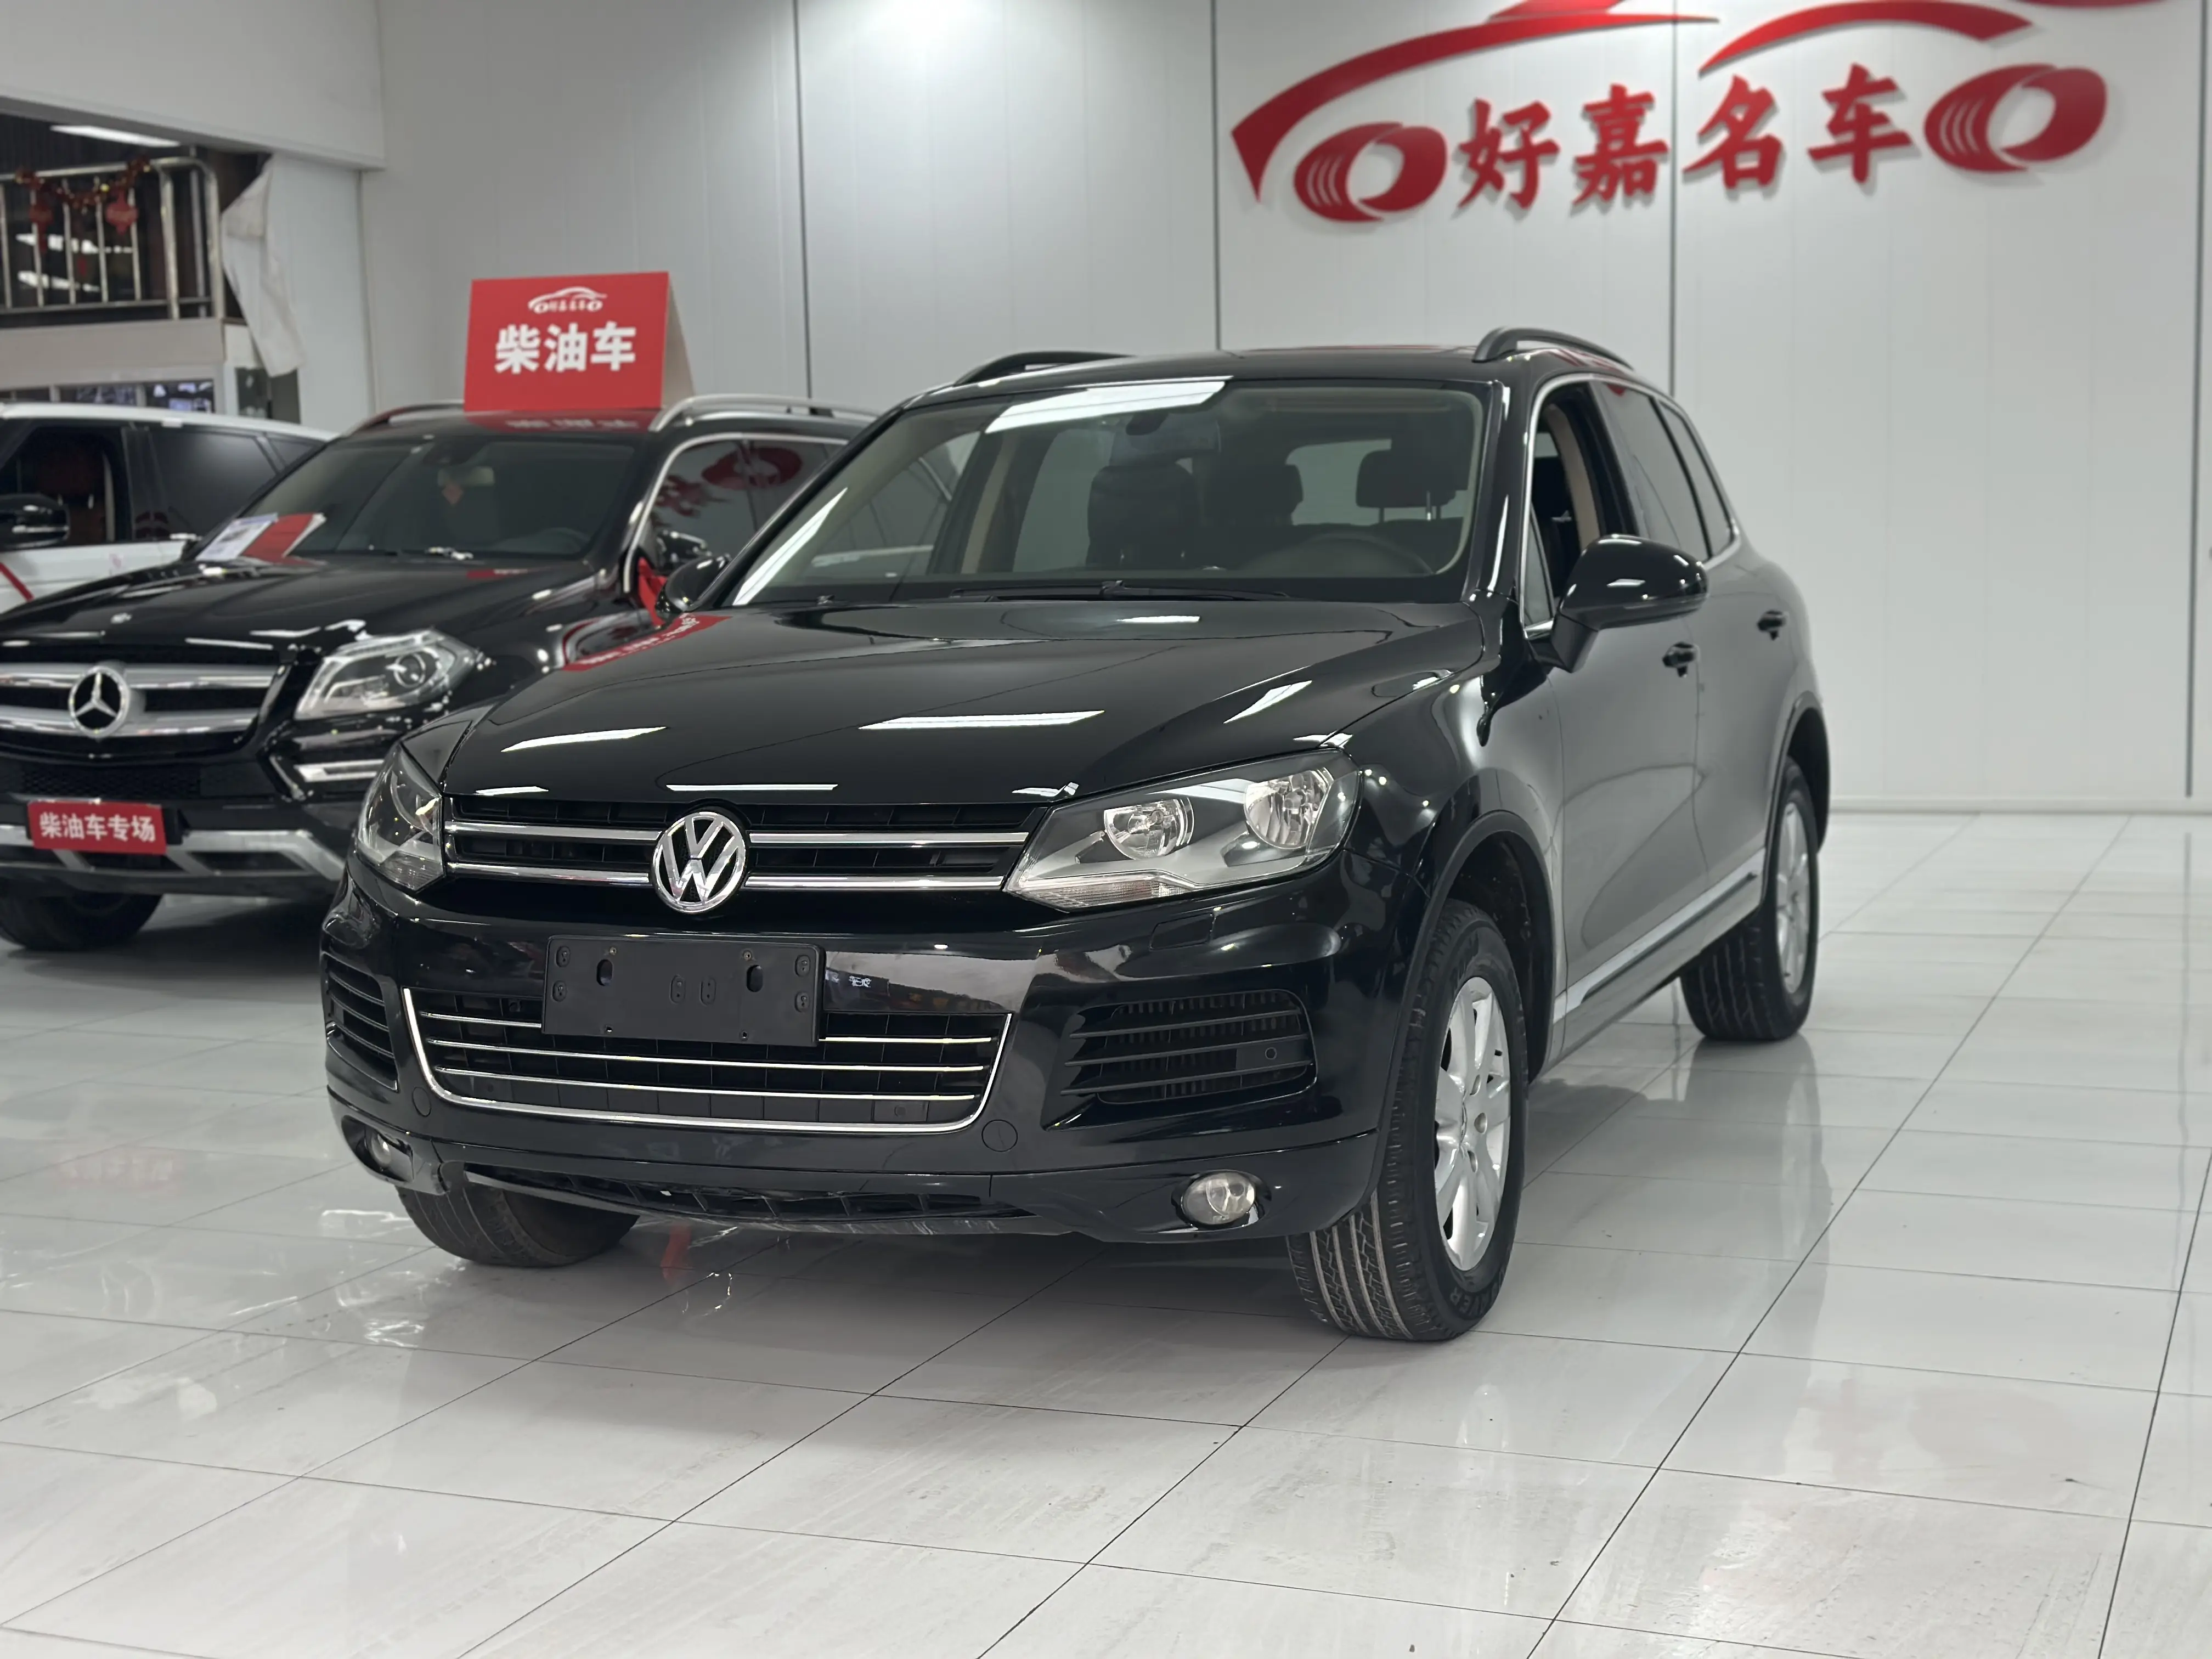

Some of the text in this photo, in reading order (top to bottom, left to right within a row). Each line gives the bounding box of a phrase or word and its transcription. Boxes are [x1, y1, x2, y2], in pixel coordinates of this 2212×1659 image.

[1458, 64, 1912, 210] 好嘉名车
[494, 320, 637, 375] 柴油车
[39, 811, 156, 843] 柴油车专场
